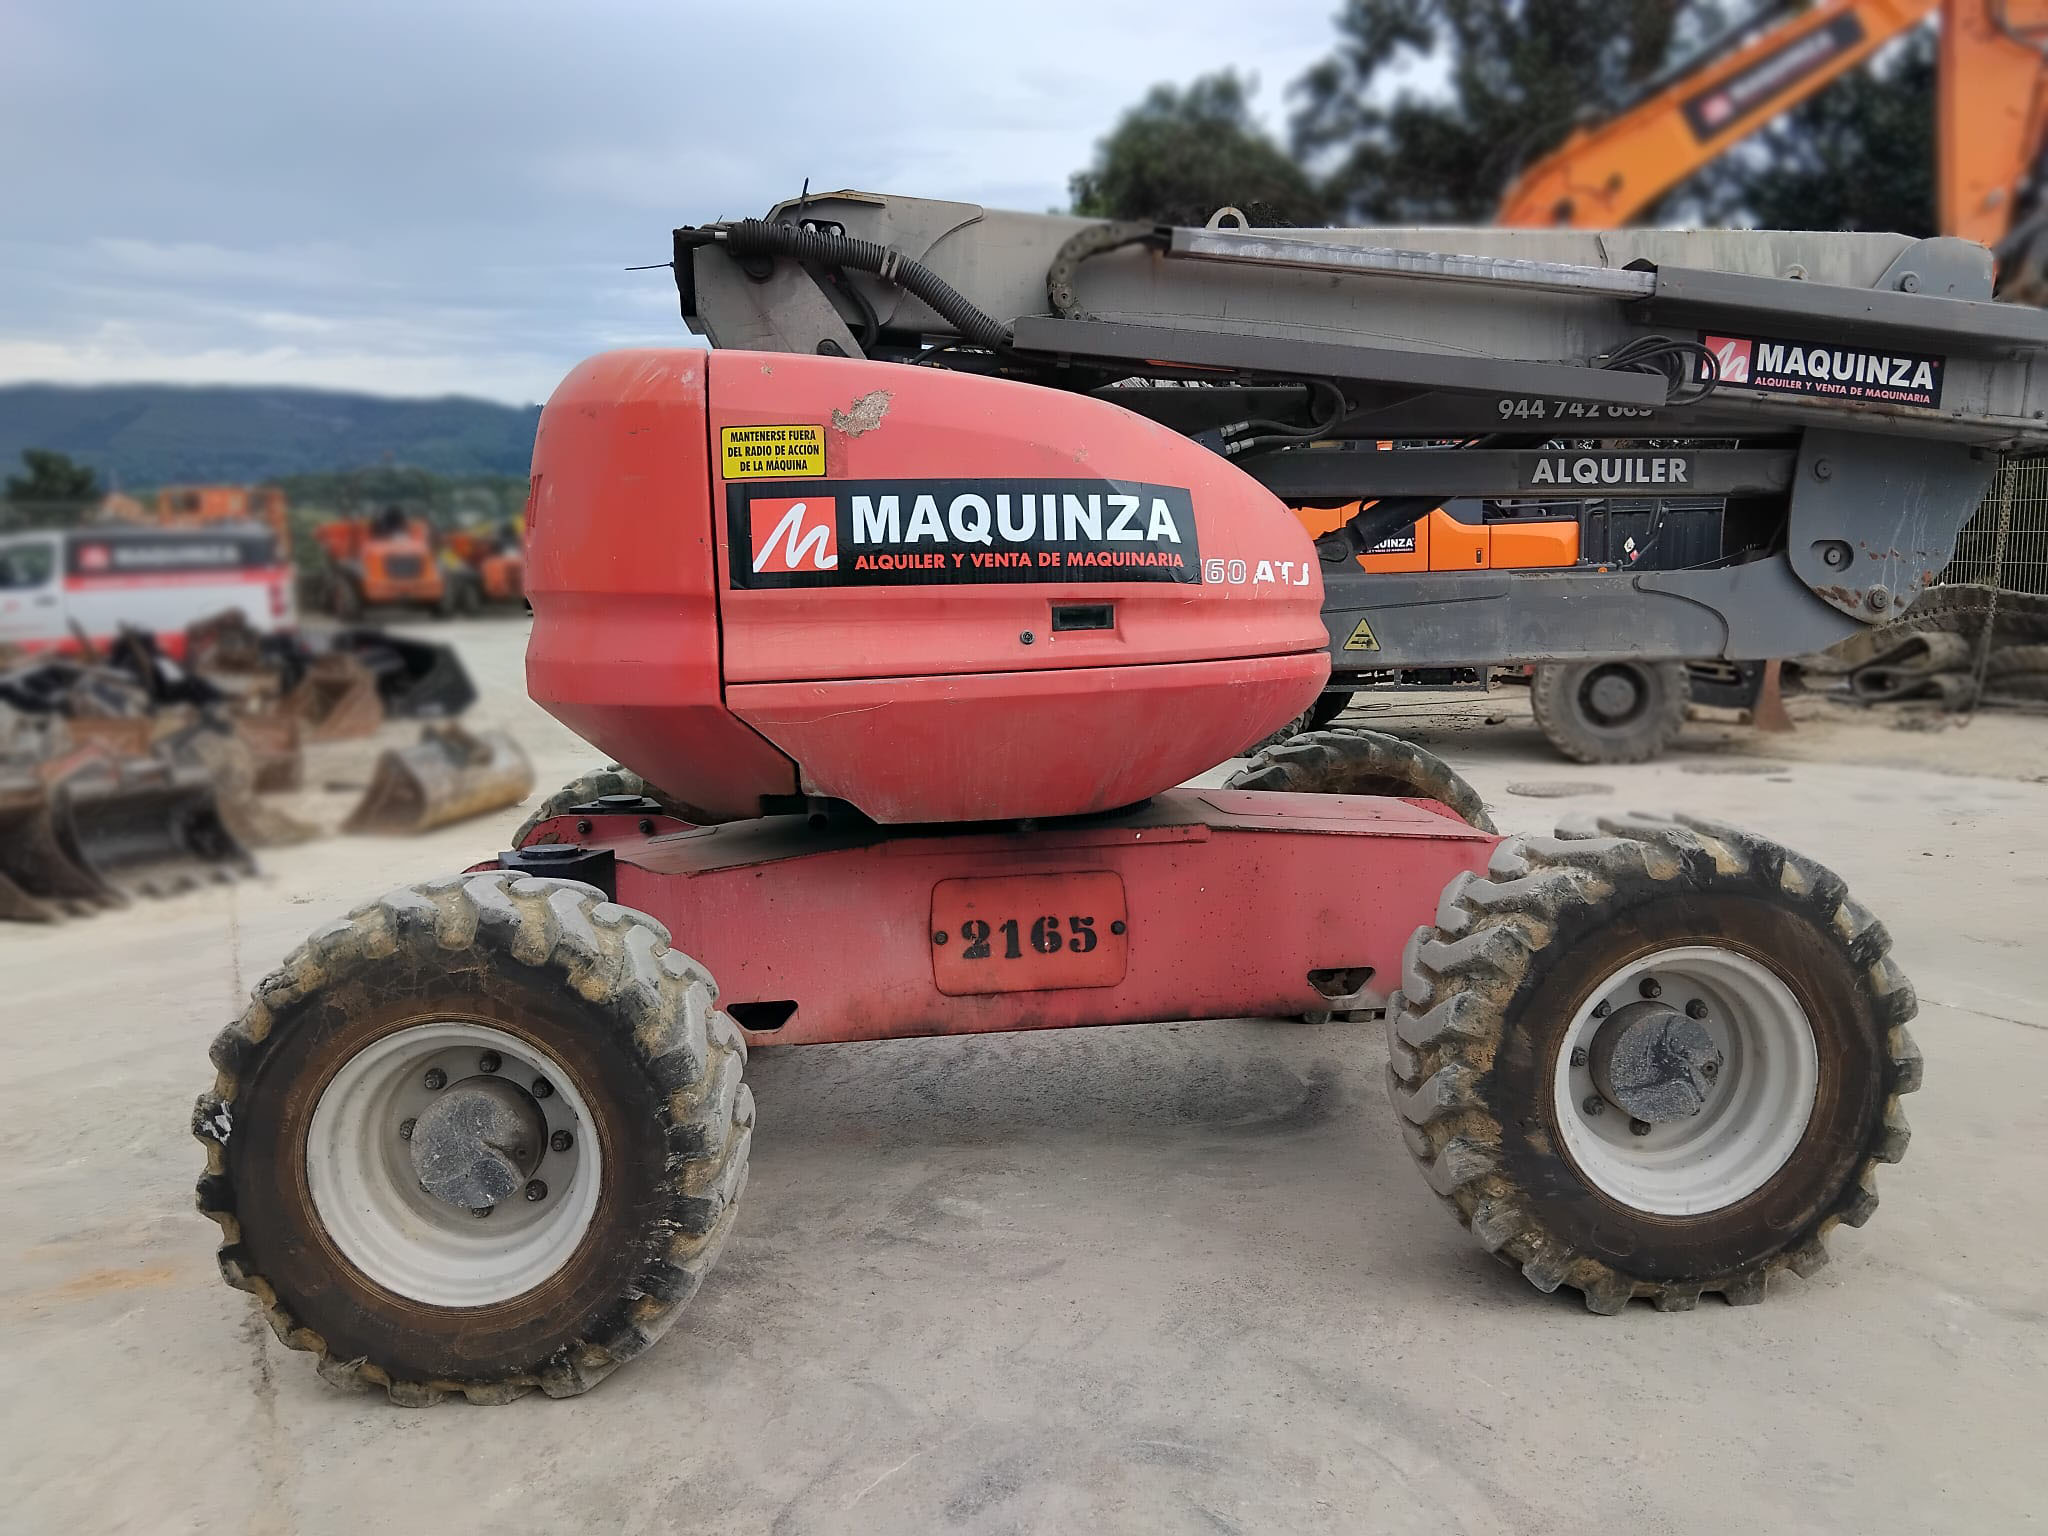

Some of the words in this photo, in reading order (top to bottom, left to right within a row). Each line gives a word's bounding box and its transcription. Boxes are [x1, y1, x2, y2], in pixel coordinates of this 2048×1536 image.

[1757, 343, 1933, 390] MAQUINZA
[1754, 376, 1802, 390] ALQUILER
[1805, 381, 1813, 391] Y
[1815, 382, 1847, 395] VENTA
[1849, 386, 1863, 396] DE
[1864, 388, 1931, 404] MAQUINARIA
[1498, 399, 1545, 420] 944
[1552, 401, 1600, 418] 742
[730, 430, 786, 442] MANTENERSE
[788, 429, 817, 441] FUERA
[727, 446, 743, 458] DEL
[745, 445, 772, 457] RADIO
[774, 444, 786, 456] DE
[788, 441, 819, 456] ACCIÓN
[740, 461, 751, 472] DE
[753, 460, 763, 471] LA
[766, 457, 807, 472] MÁQUINA
[1531, 458, 1687, 484] ALQUILER
[851, 493, 1182, 546] MAQUINZA
[855, 553, 945, 570] ALQUILER
[951, 553, 965, 568] Y
[970, 552, 1032, 568] VENTA
[1038, 552, 1061, 567] DE
[1067, 551, 1184, 567] MAQUINARIA
[1200, 558, 1247, 585] 60
[1252, 560, 1309, 586] ATJ
[961, 915, 1098, 959] 2165
